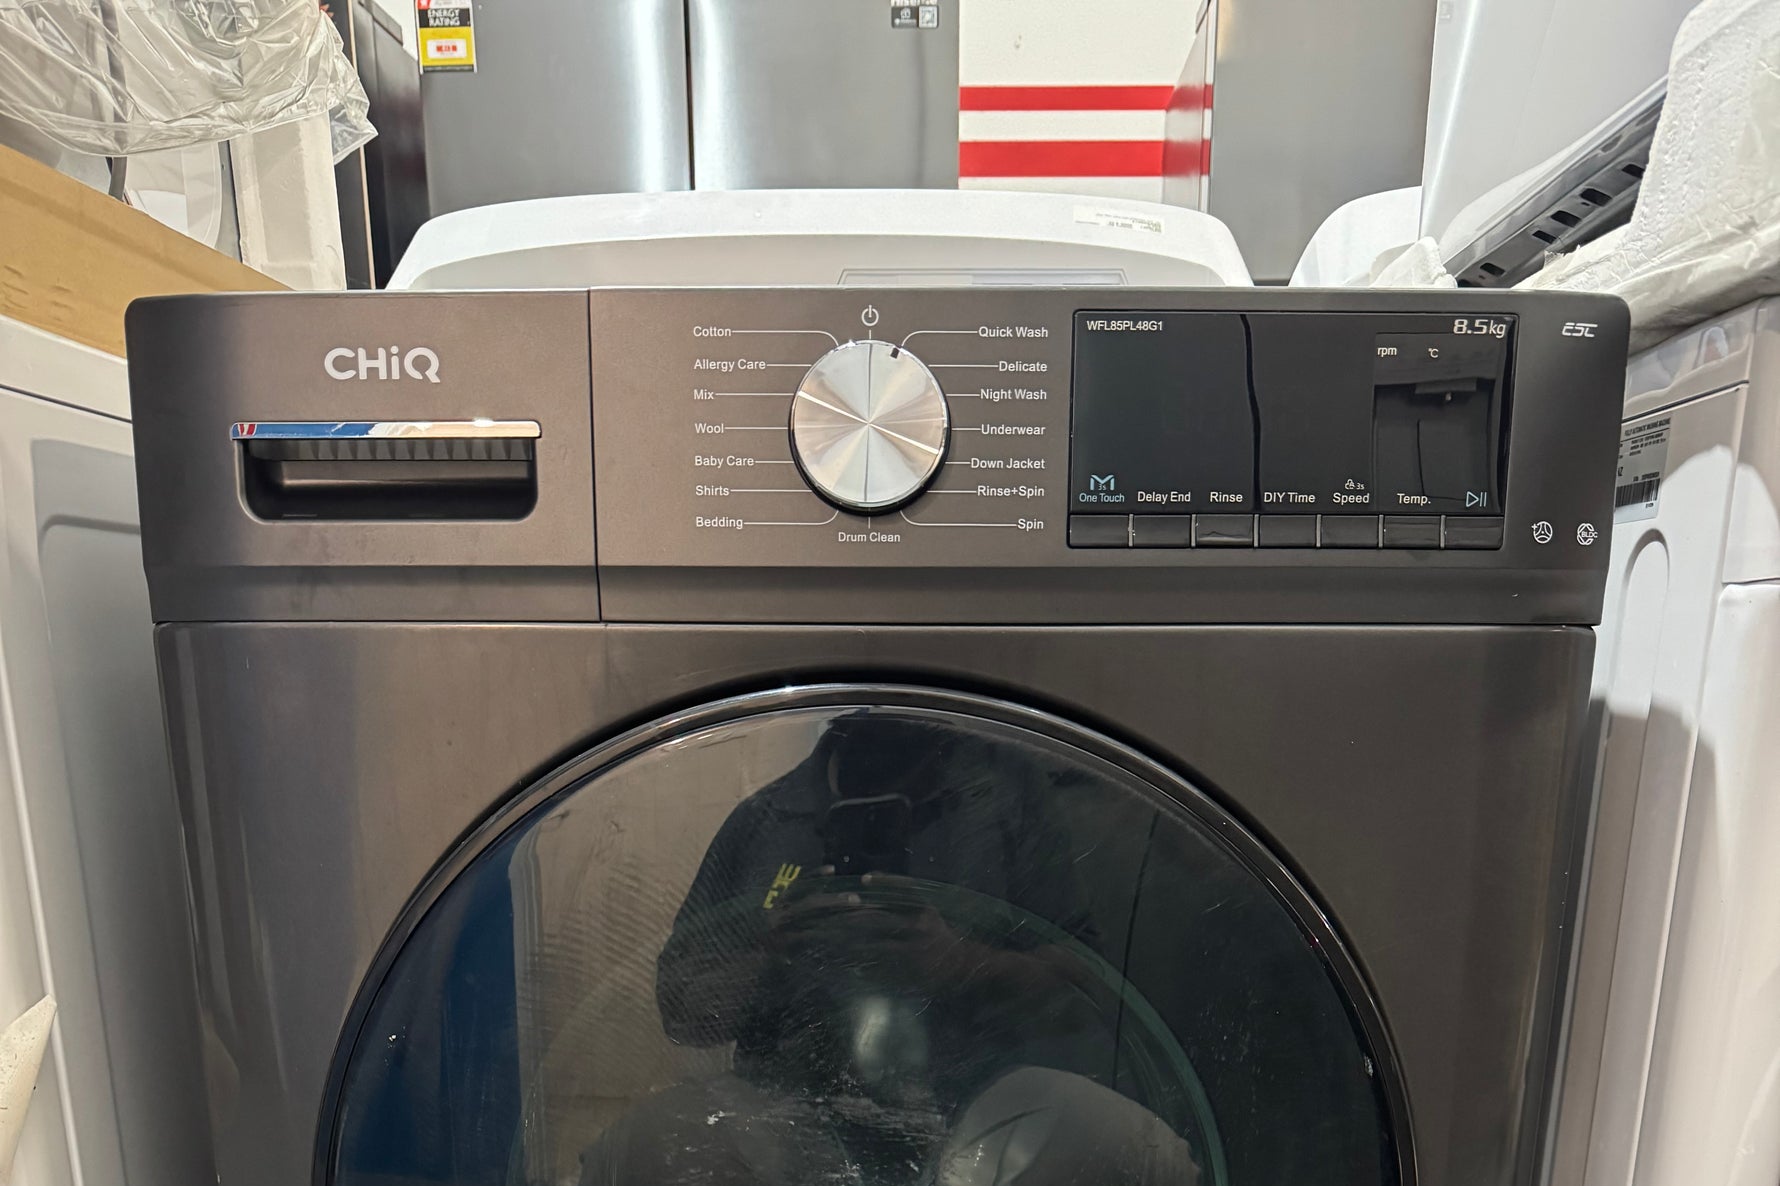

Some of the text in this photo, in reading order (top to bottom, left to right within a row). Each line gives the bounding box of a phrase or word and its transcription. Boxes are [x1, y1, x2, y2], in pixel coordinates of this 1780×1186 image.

[428, 9, 460, 17] ENERGY
[429, 17, 460, 26] RATING
[693, 326, 732, 337] Cotton
[1087, 320, 1164, 332] WFL85PL48G1
[1453, 318, 1506, 338] 8.5kg
[979, 326, 1048, 339] Quick Wash
[1378, 346, 1397, 357] rpm
[324, 346, 440, 383] CHiQ
[694, 359, 766, 372] Allergy Care
[999, 361, 1047, 372] Delicate
[694, 389, 714, 400] Mix
[981, 389, 1047, 402] Night Wash
[695, 423, 724, 434] Wool
[981, 424, 1046, 435] Underwear
[695, 456, 754, 468] Baby Care
[971, 458, 1045, 470] Down Jacket
[696, 486, 730, 496] Shirts
[978, 486, 1045, 499] Rinse+Spin
[1210, 492, 1243, 502] Rinse
[1079, 493, 1125, 503] One Touch
[1138, 491, 1191, 504] Delay End
[1264, 493, 1316, 503] DIY Time
[1333, 493, 1370, 505] Speed
[1397, 493, 1431, 506] Temp.
[696, 517, 743, 530] Bedding
[1018, 518, 1044, 532] Spin
[838, 532, 900, 543] Drum Clean
